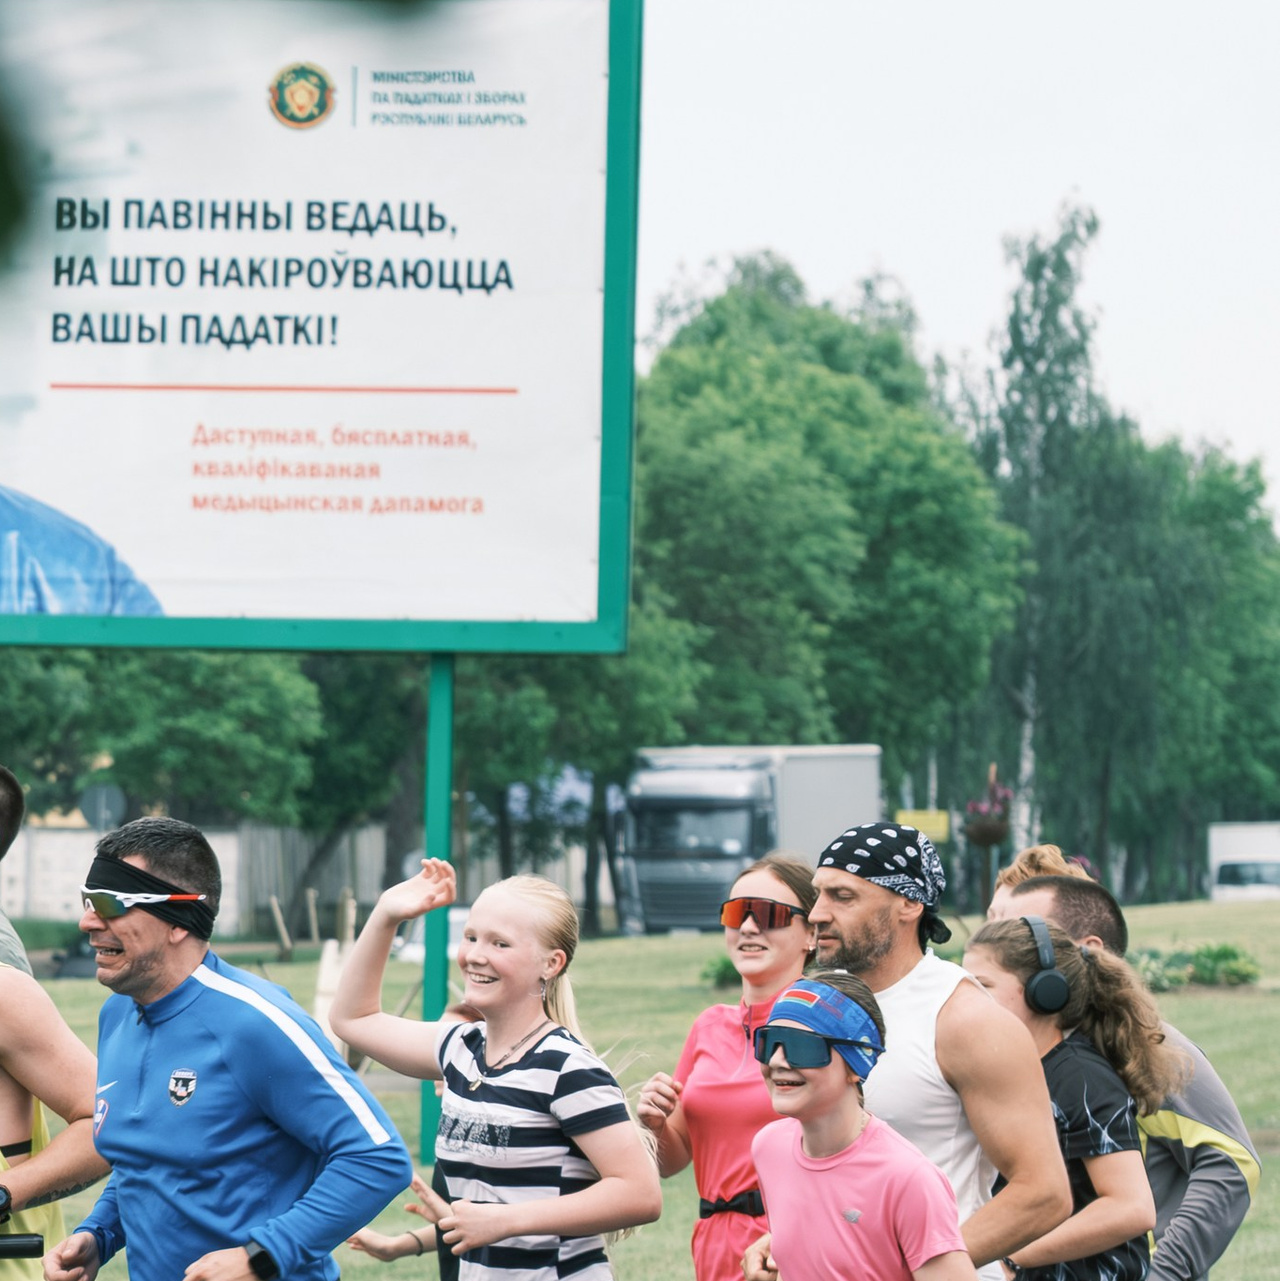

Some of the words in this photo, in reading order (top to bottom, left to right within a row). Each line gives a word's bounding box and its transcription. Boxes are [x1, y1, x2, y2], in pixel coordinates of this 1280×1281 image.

[56, 198, 110, 231] ВЫ
[124, 199, 292, 231] ПАВІННЫ
[306, 201, 456, 237] ВЕДАЦЬ,
[54, 255, 98, 287] НА
[110, 256, 186, 288] ШТО
[199, 251, 514, 295] НАКІРОЎВАЮЦЦА
[52, 312, 167, 344] ВАШЫ
[181, 314, 338, 350] ПАДАТКІ!
[191, 422, 324, 449] Даступная,
[369, 497, 484, 514] дапамога
